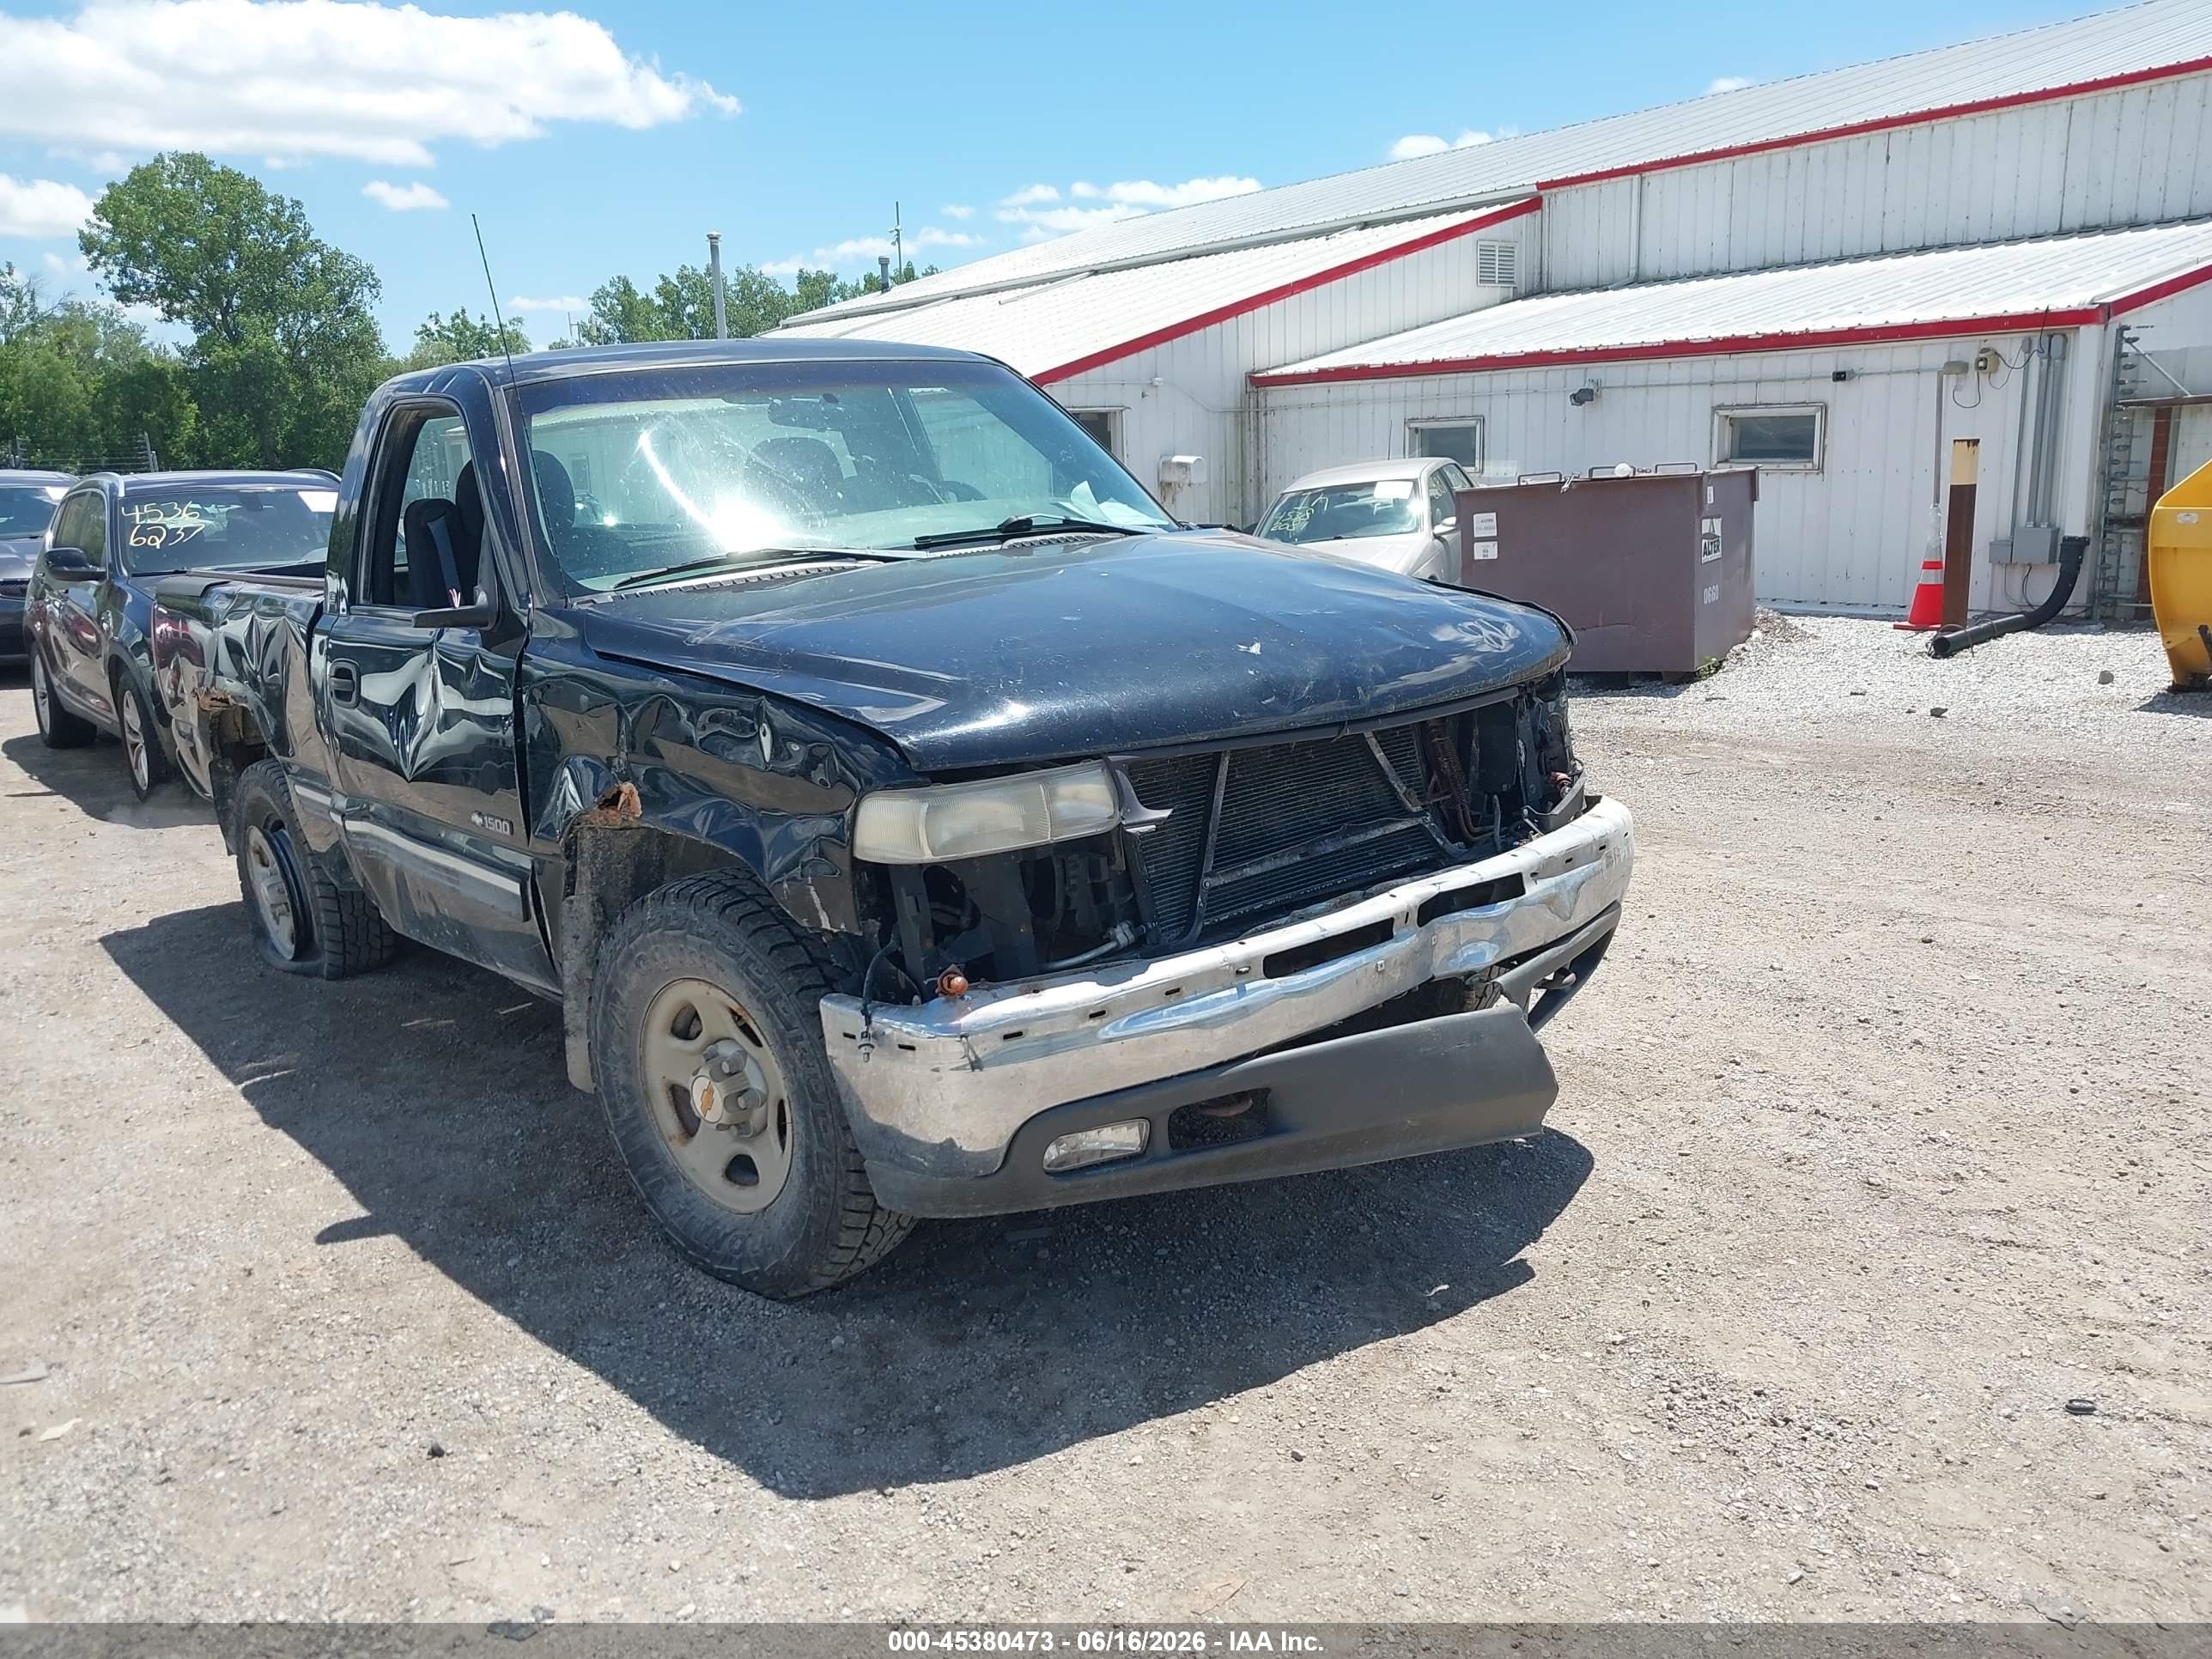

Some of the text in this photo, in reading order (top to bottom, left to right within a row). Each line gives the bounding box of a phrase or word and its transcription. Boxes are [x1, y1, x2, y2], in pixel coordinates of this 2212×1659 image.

[122, 501, 200, 524] 4536
[129, 523, 206, 549] 6237
[1703, 539, 1721, 557] ALTER
[483, 815, 511, 836] 1500
